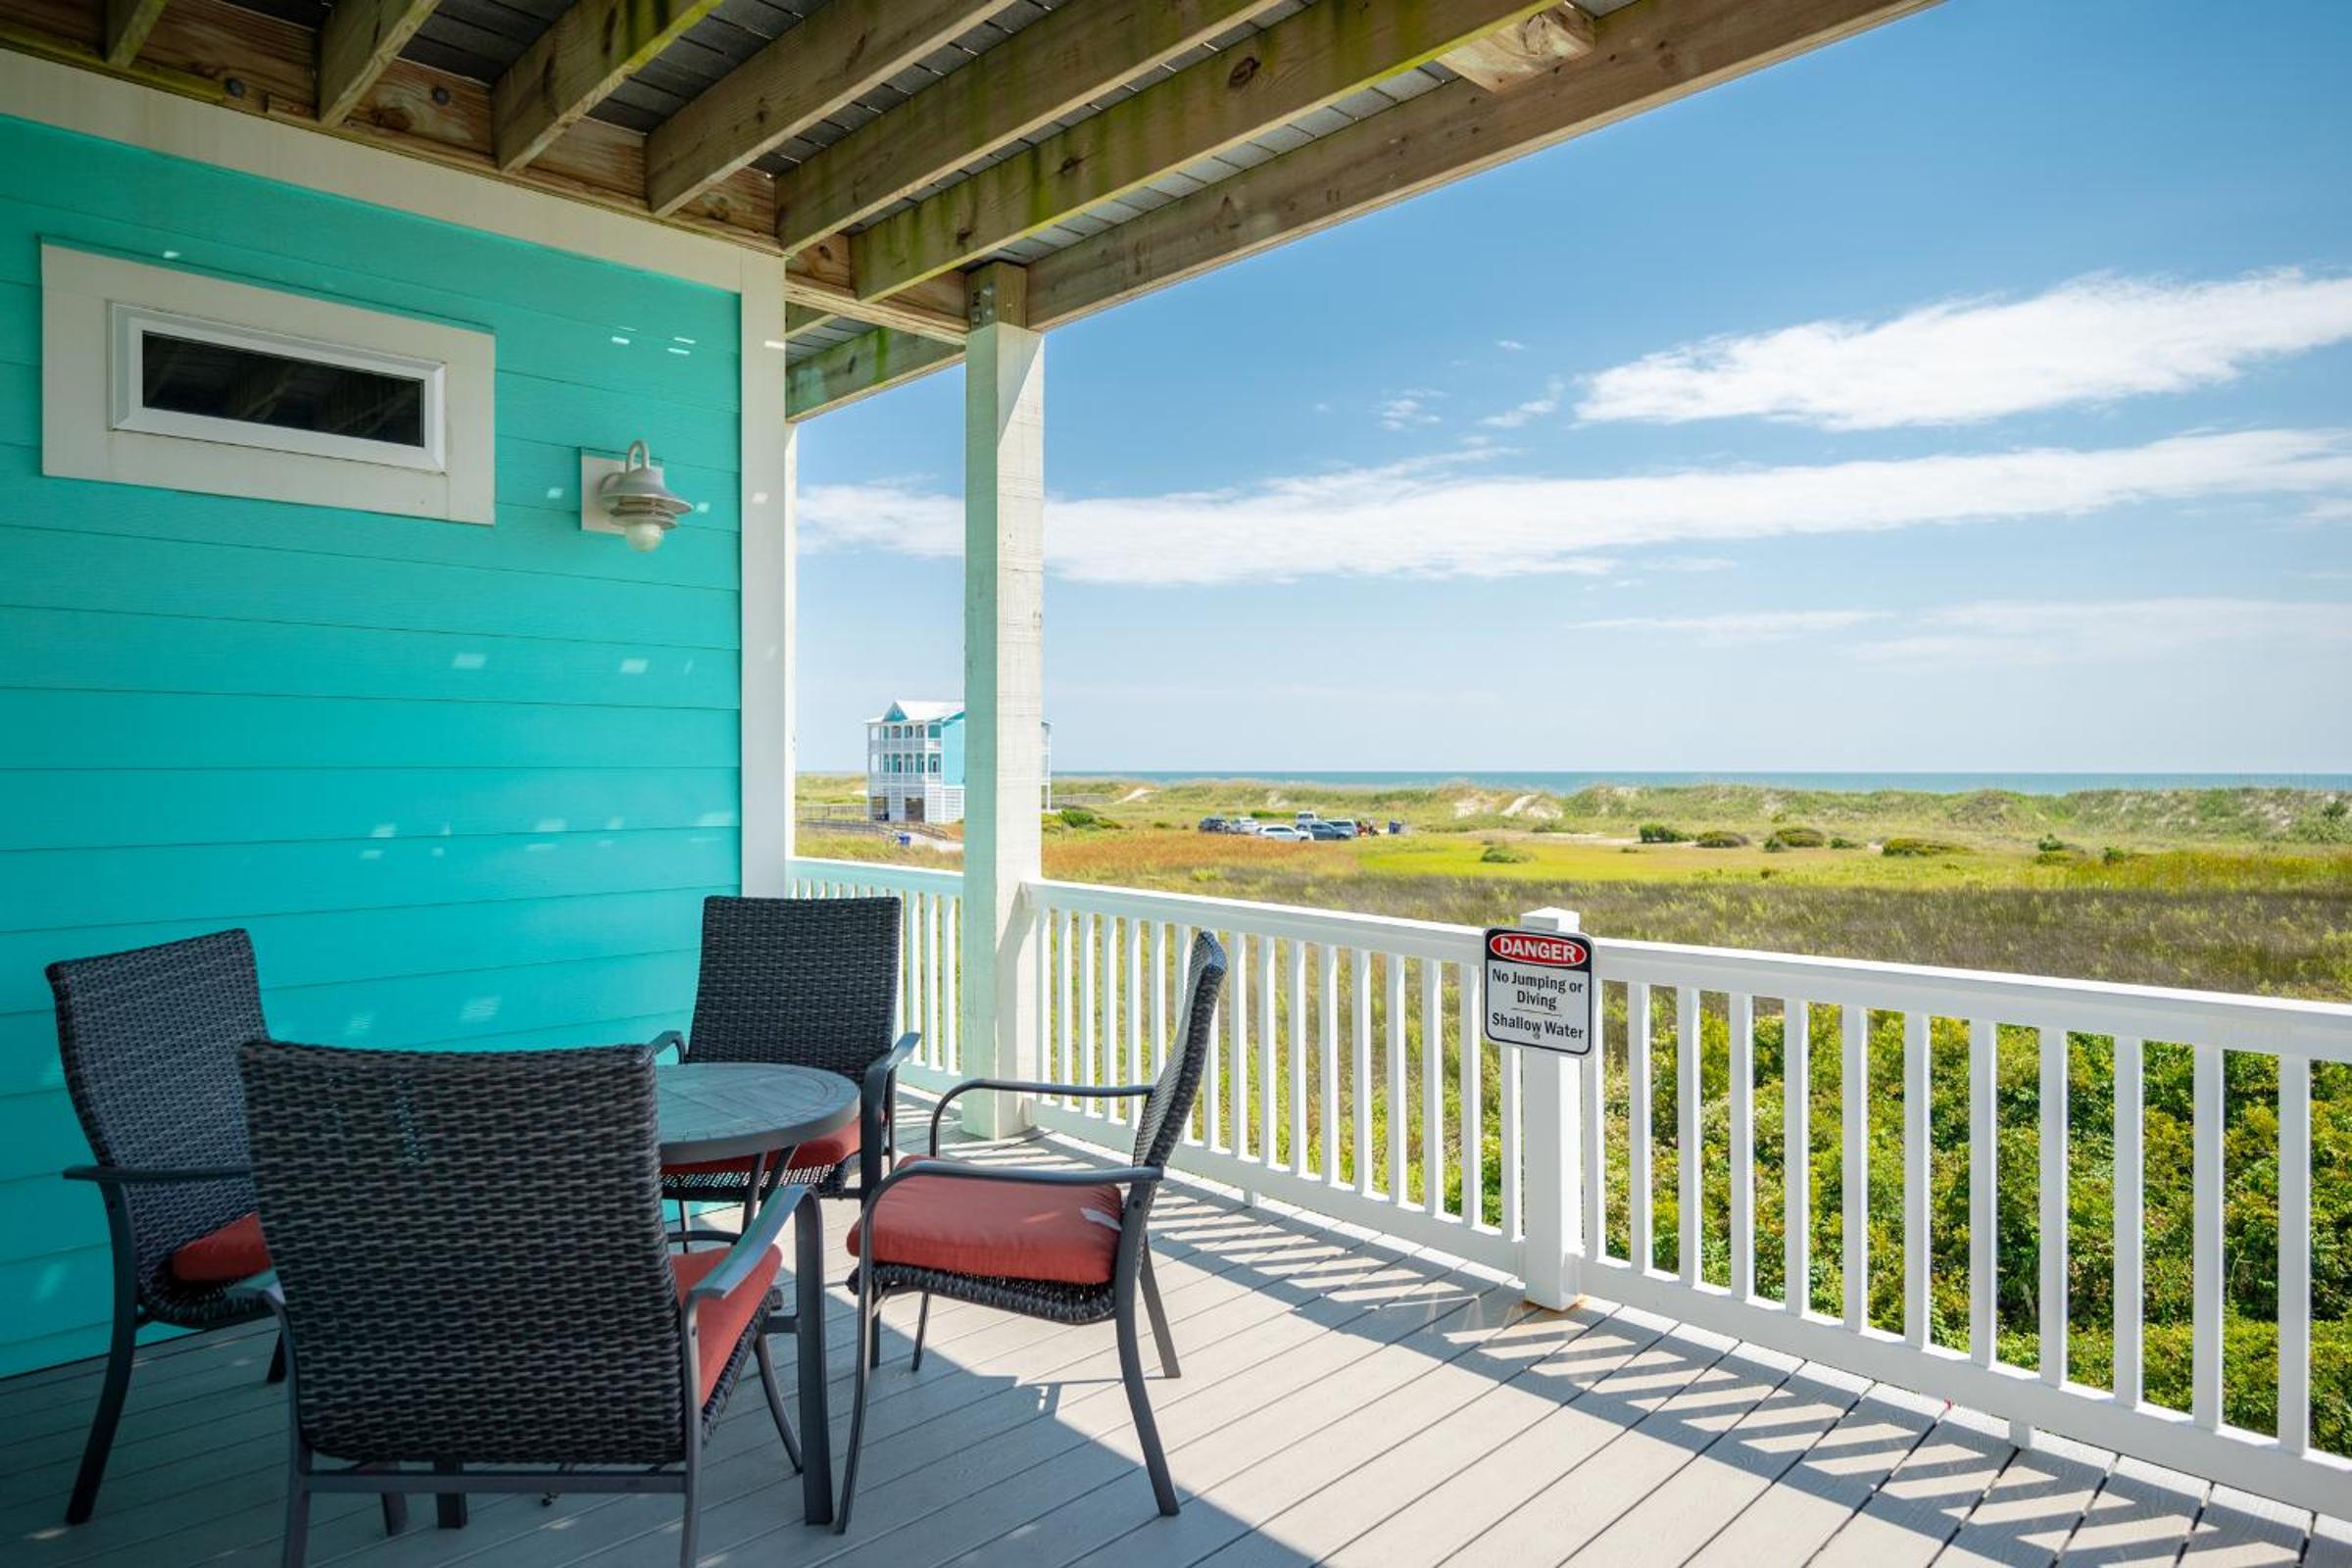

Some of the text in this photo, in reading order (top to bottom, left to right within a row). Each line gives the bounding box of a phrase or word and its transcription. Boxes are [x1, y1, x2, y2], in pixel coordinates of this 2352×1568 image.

[1499, 937, 1577, 961] DANGER
[1492, 968, 1584, 994] No Jumping or
[1517, 990, 1556, 1010] Diving
[1492, 1012, 1585, 1039] Shallow Water
